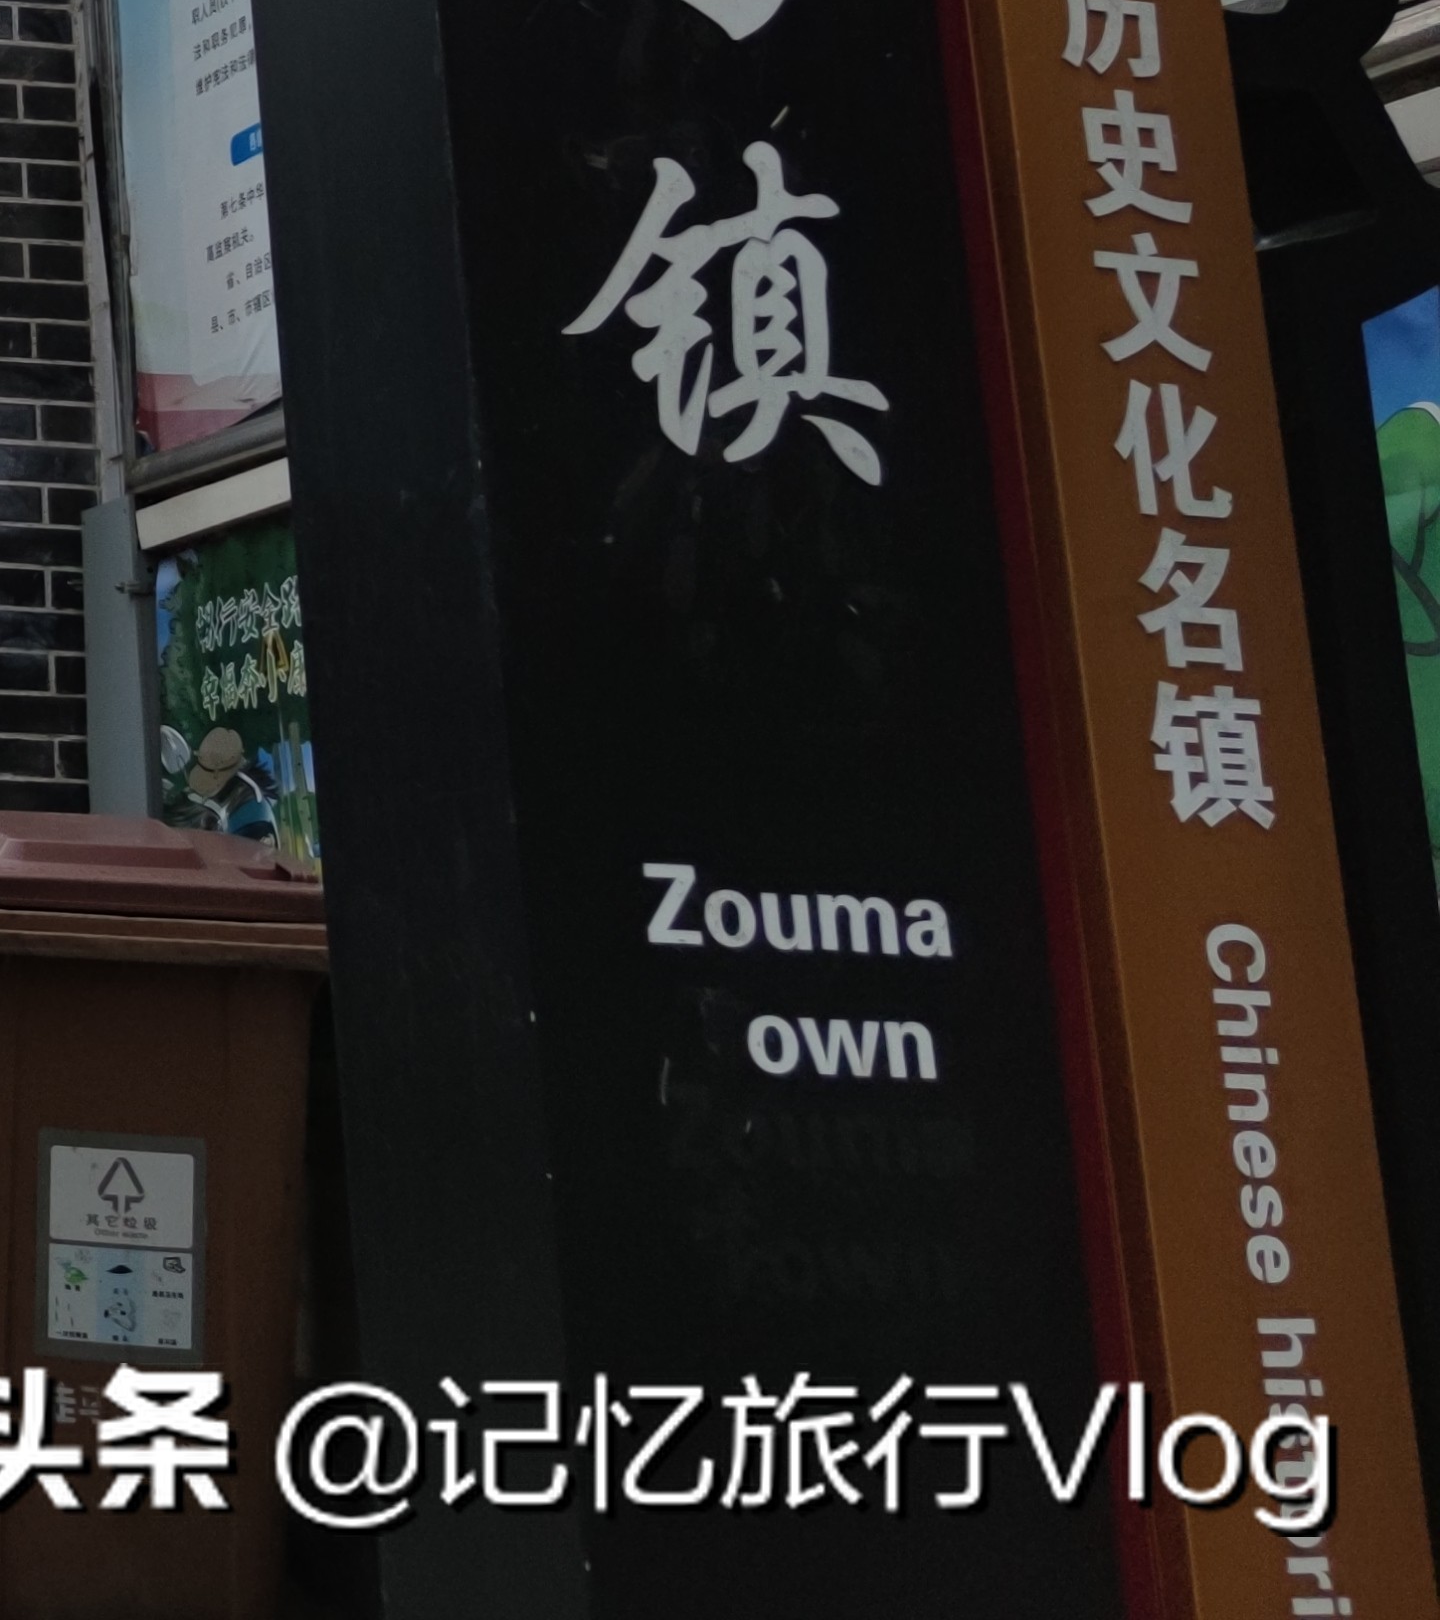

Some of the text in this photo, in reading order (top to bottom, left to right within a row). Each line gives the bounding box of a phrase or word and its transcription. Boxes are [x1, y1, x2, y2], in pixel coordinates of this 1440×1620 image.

[641, 861, 954, 958] Zouma
[746, 1013, 939, 1080] own
[1205, 922, 1292, 1285] Chinese
